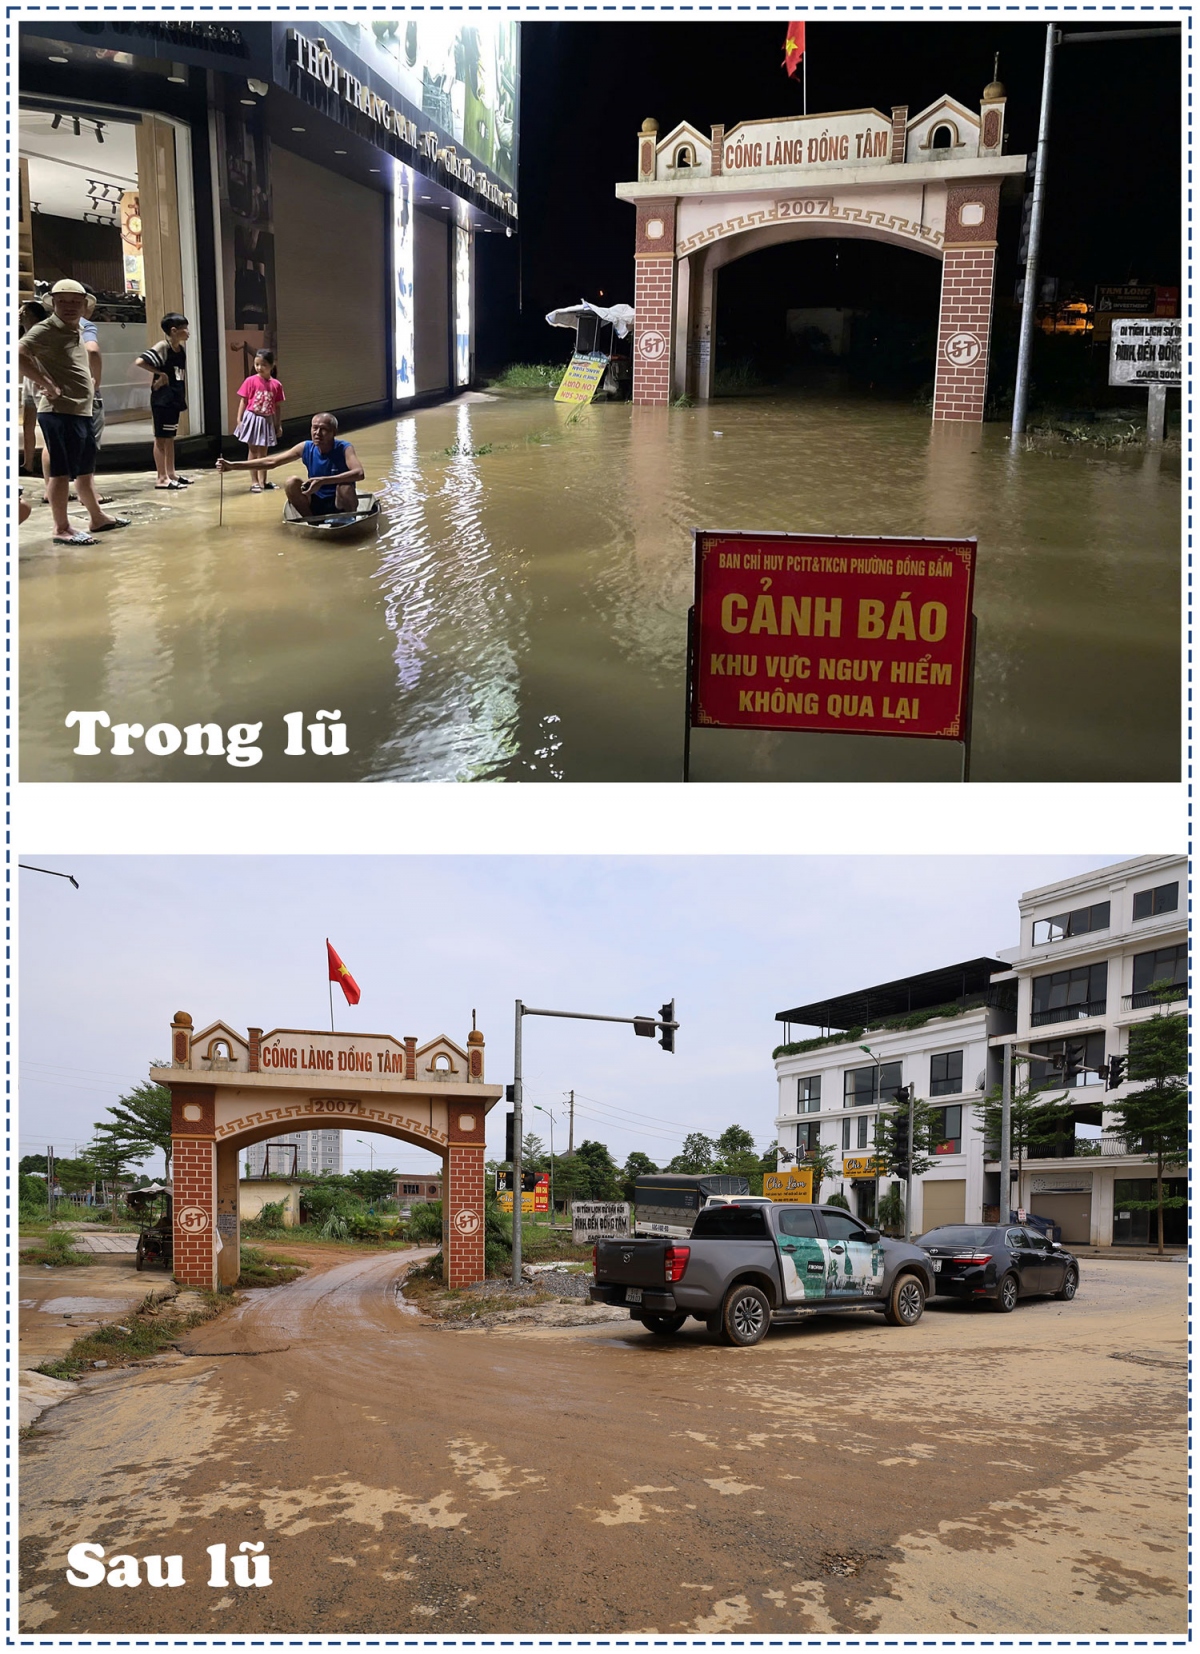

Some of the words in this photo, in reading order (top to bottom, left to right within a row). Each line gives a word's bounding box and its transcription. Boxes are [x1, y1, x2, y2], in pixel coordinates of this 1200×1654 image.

[293, 28, 340, 95] THỜI
[343, 68, 390, 130] TRANG
[392, 108, 417, 149] NAM
[725, 134, 762, 169] CỔNG
[766, 136, 802, 166] LÀNG
[808, 129, 849, 163] ĐỒNG
[855, 128, 888, 158] TÂM
[780, 200, 828, 216] 2007
[719, 554, 741, 569] BAN
[743, 549, 761, 571] CHỈ
[764, 556, 784, 571] HUY
[787, 555, 847, 573] PCTT&TKCN
[850, 555, 893, 575] PHƯỜNG
[896, 555, 925, 577] ĐỒNG
[928, 554, 953, 577] BẨM
[721, 577, 842, 638] CẢNH
[857, 592, 948, 642] BÁO
[710, 654, 757, 676] KHU
[765, 654, 811, 683] VỰC
[819, 658, 884, 682] NGUY
[891, 654, 952, 685] HIỂM
[739, 688, 819, 715] KHÔNG
[827, 694, 874, 719] QUA
[882, 697, 919, 723] LẠI
[263, 1039, 297, 1068] CỔNG
[301, 1045, 333, 1070] LÀNG
[337, 1045, 372, 1072] ĐỒNG
[377, 1050, 403, 1073] TÂM
[315, 1101, 357, 1113] 2007
